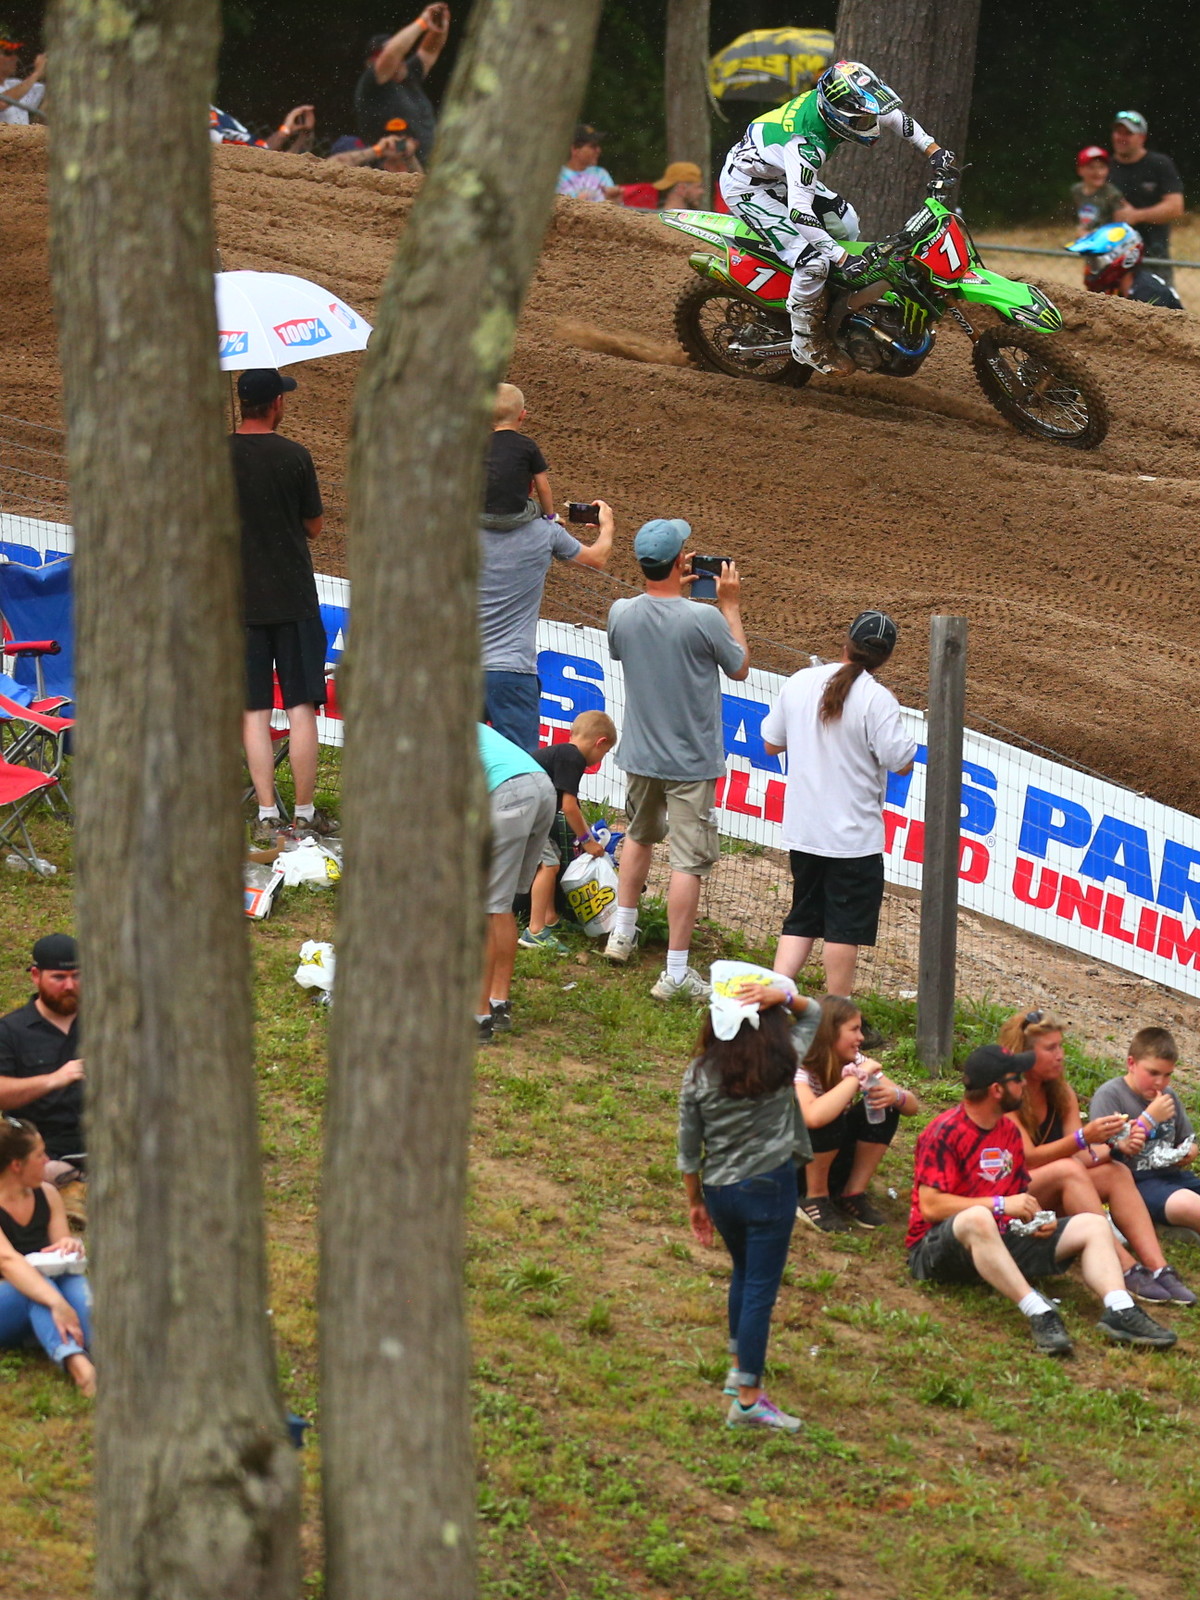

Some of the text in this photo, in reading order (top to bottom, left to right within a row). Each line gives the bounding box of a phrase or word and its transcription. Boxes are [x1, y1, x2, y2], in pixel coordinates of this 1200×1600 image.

[939, 232, 961, 272] 1
[745, 266, 777, 292] 1
[277, 319, 326, 345] 100%
[568, 880, 599, 907] OTO
